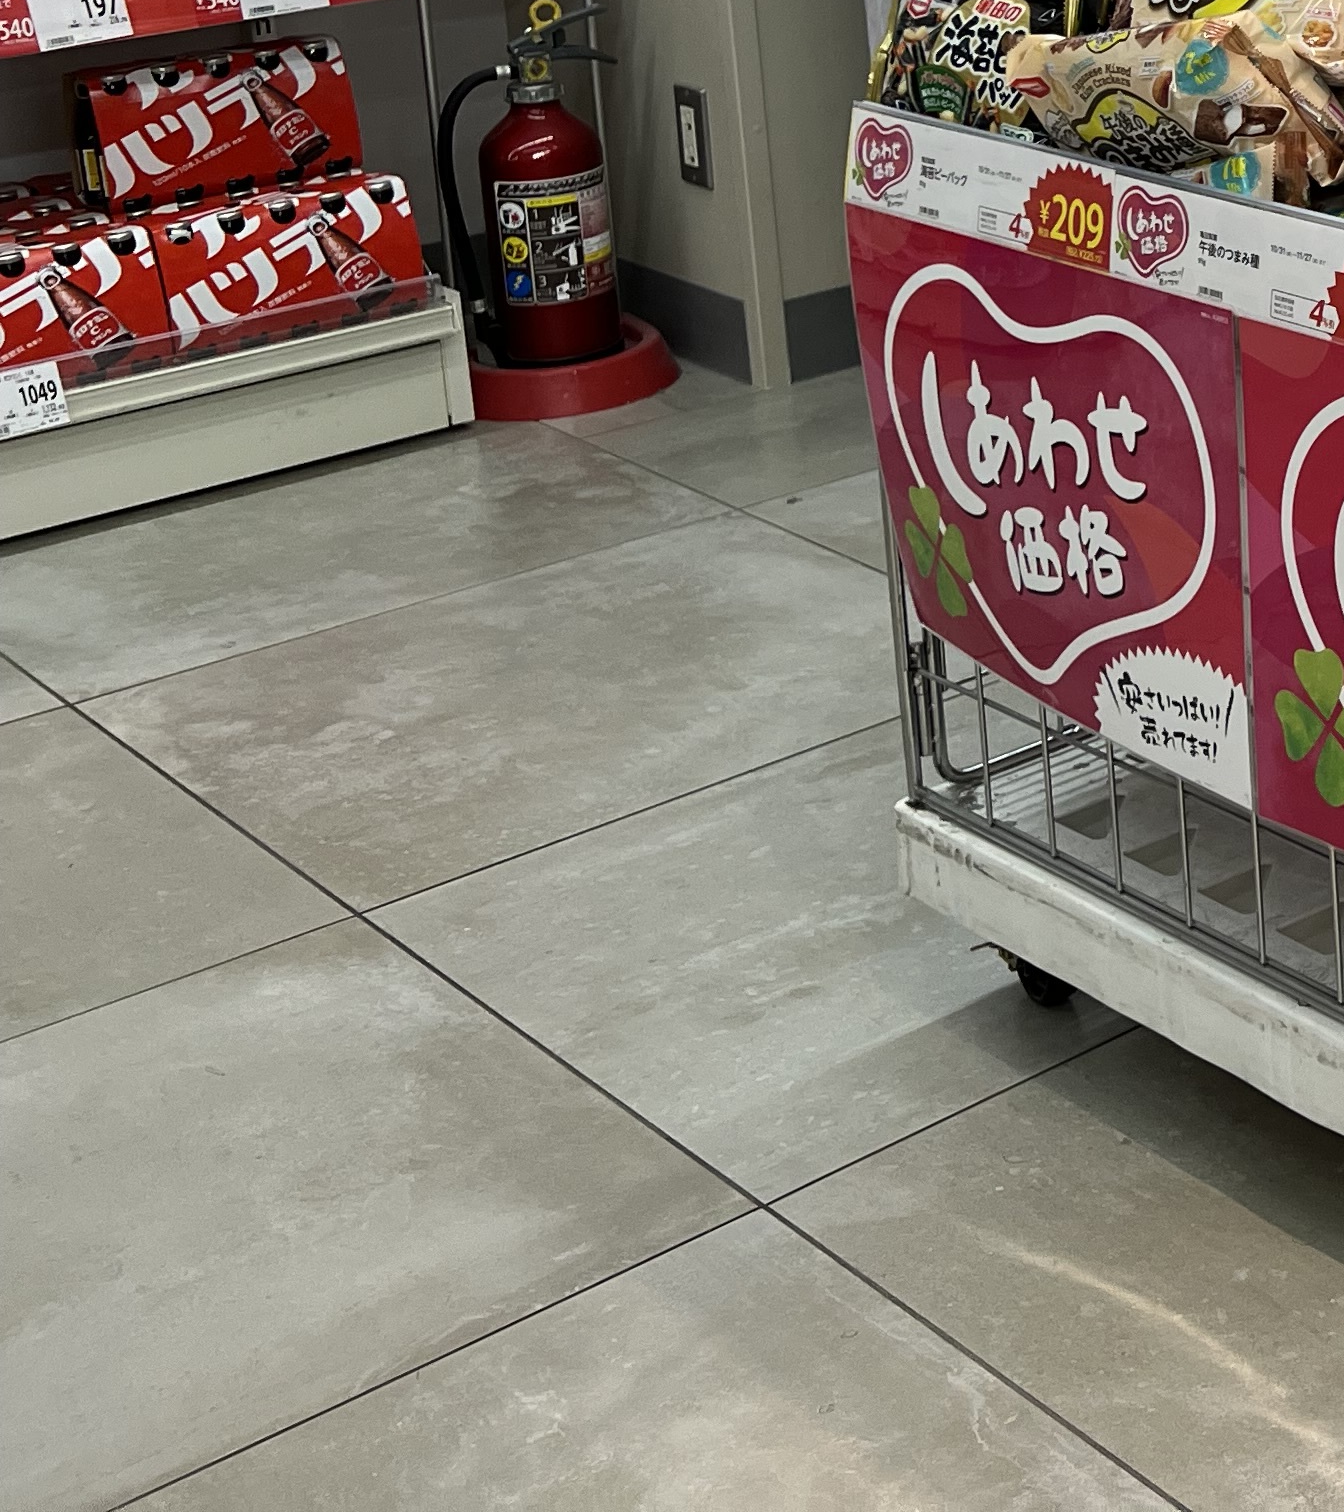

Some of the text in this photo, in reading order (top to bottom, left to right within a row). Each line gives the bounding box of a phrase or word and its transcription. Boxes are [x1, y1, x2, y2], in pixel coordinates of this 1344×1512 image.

[18, 380, 58, 407] 1049
[922, 350, 1148, 517] しあわせ
[1000, 503, 1128, 600] 価格
[1140, 716, 1220, 765] 売れてます!
